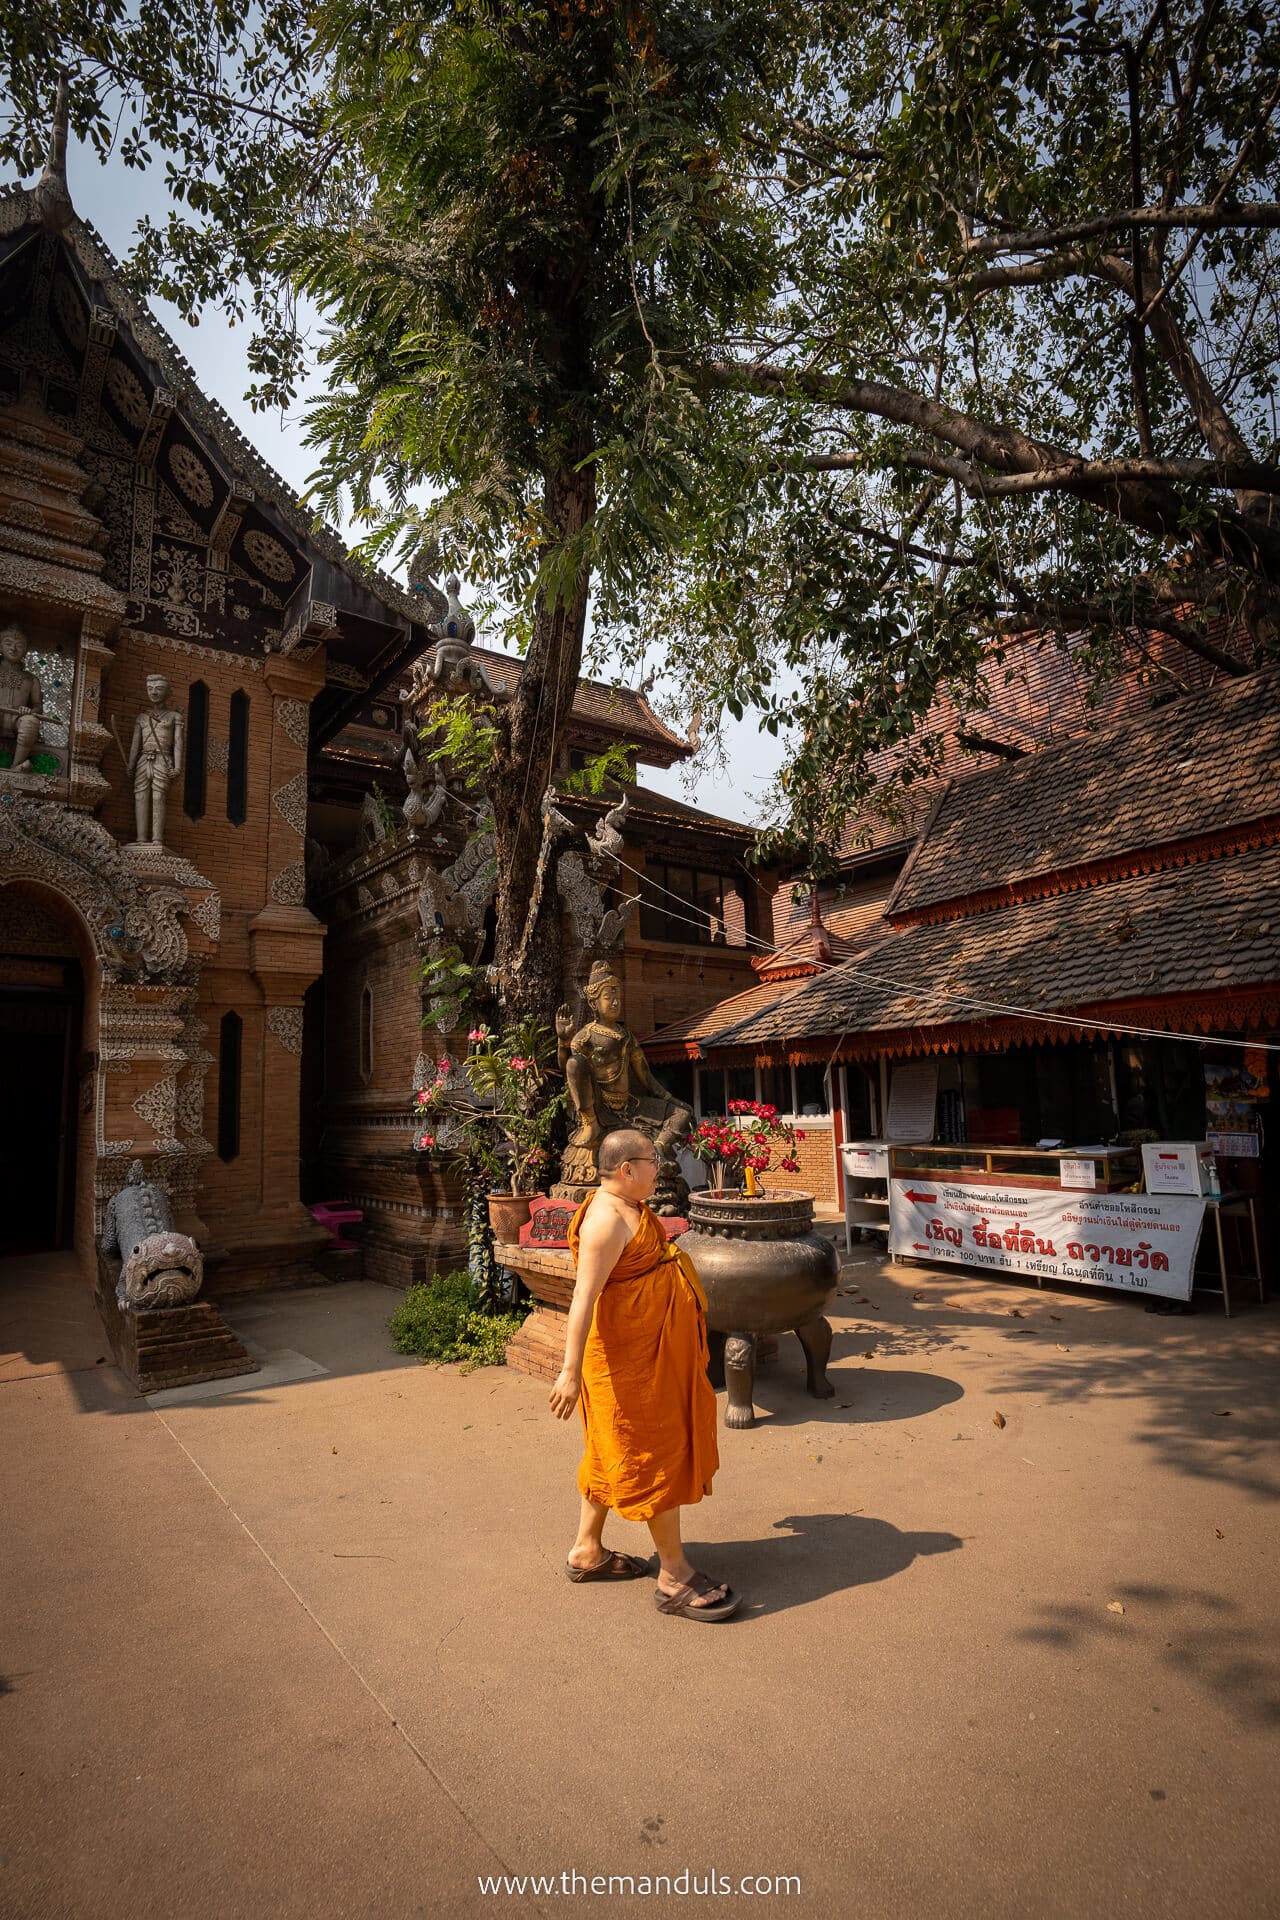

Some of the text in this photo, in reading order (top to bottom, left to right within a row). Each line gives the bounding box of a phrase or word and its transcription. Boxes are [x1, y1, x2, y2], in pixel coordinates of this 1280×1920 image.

[925, 1217, 1170, 1272] เชิญ ซื้อที่ดิน ถวายวัด
[959, 1251, 974, 1261] 100
[977, 1255, 996, 1264] บาท
[999, 1254, 1012, 1267] รับ
[1026, 1259, 1058, 1276] เหรียญ
[1062, 1263, 1114, 1281] โฉนดที่ดิน
[1130, 1272, 1148, 1288] ใบ)
